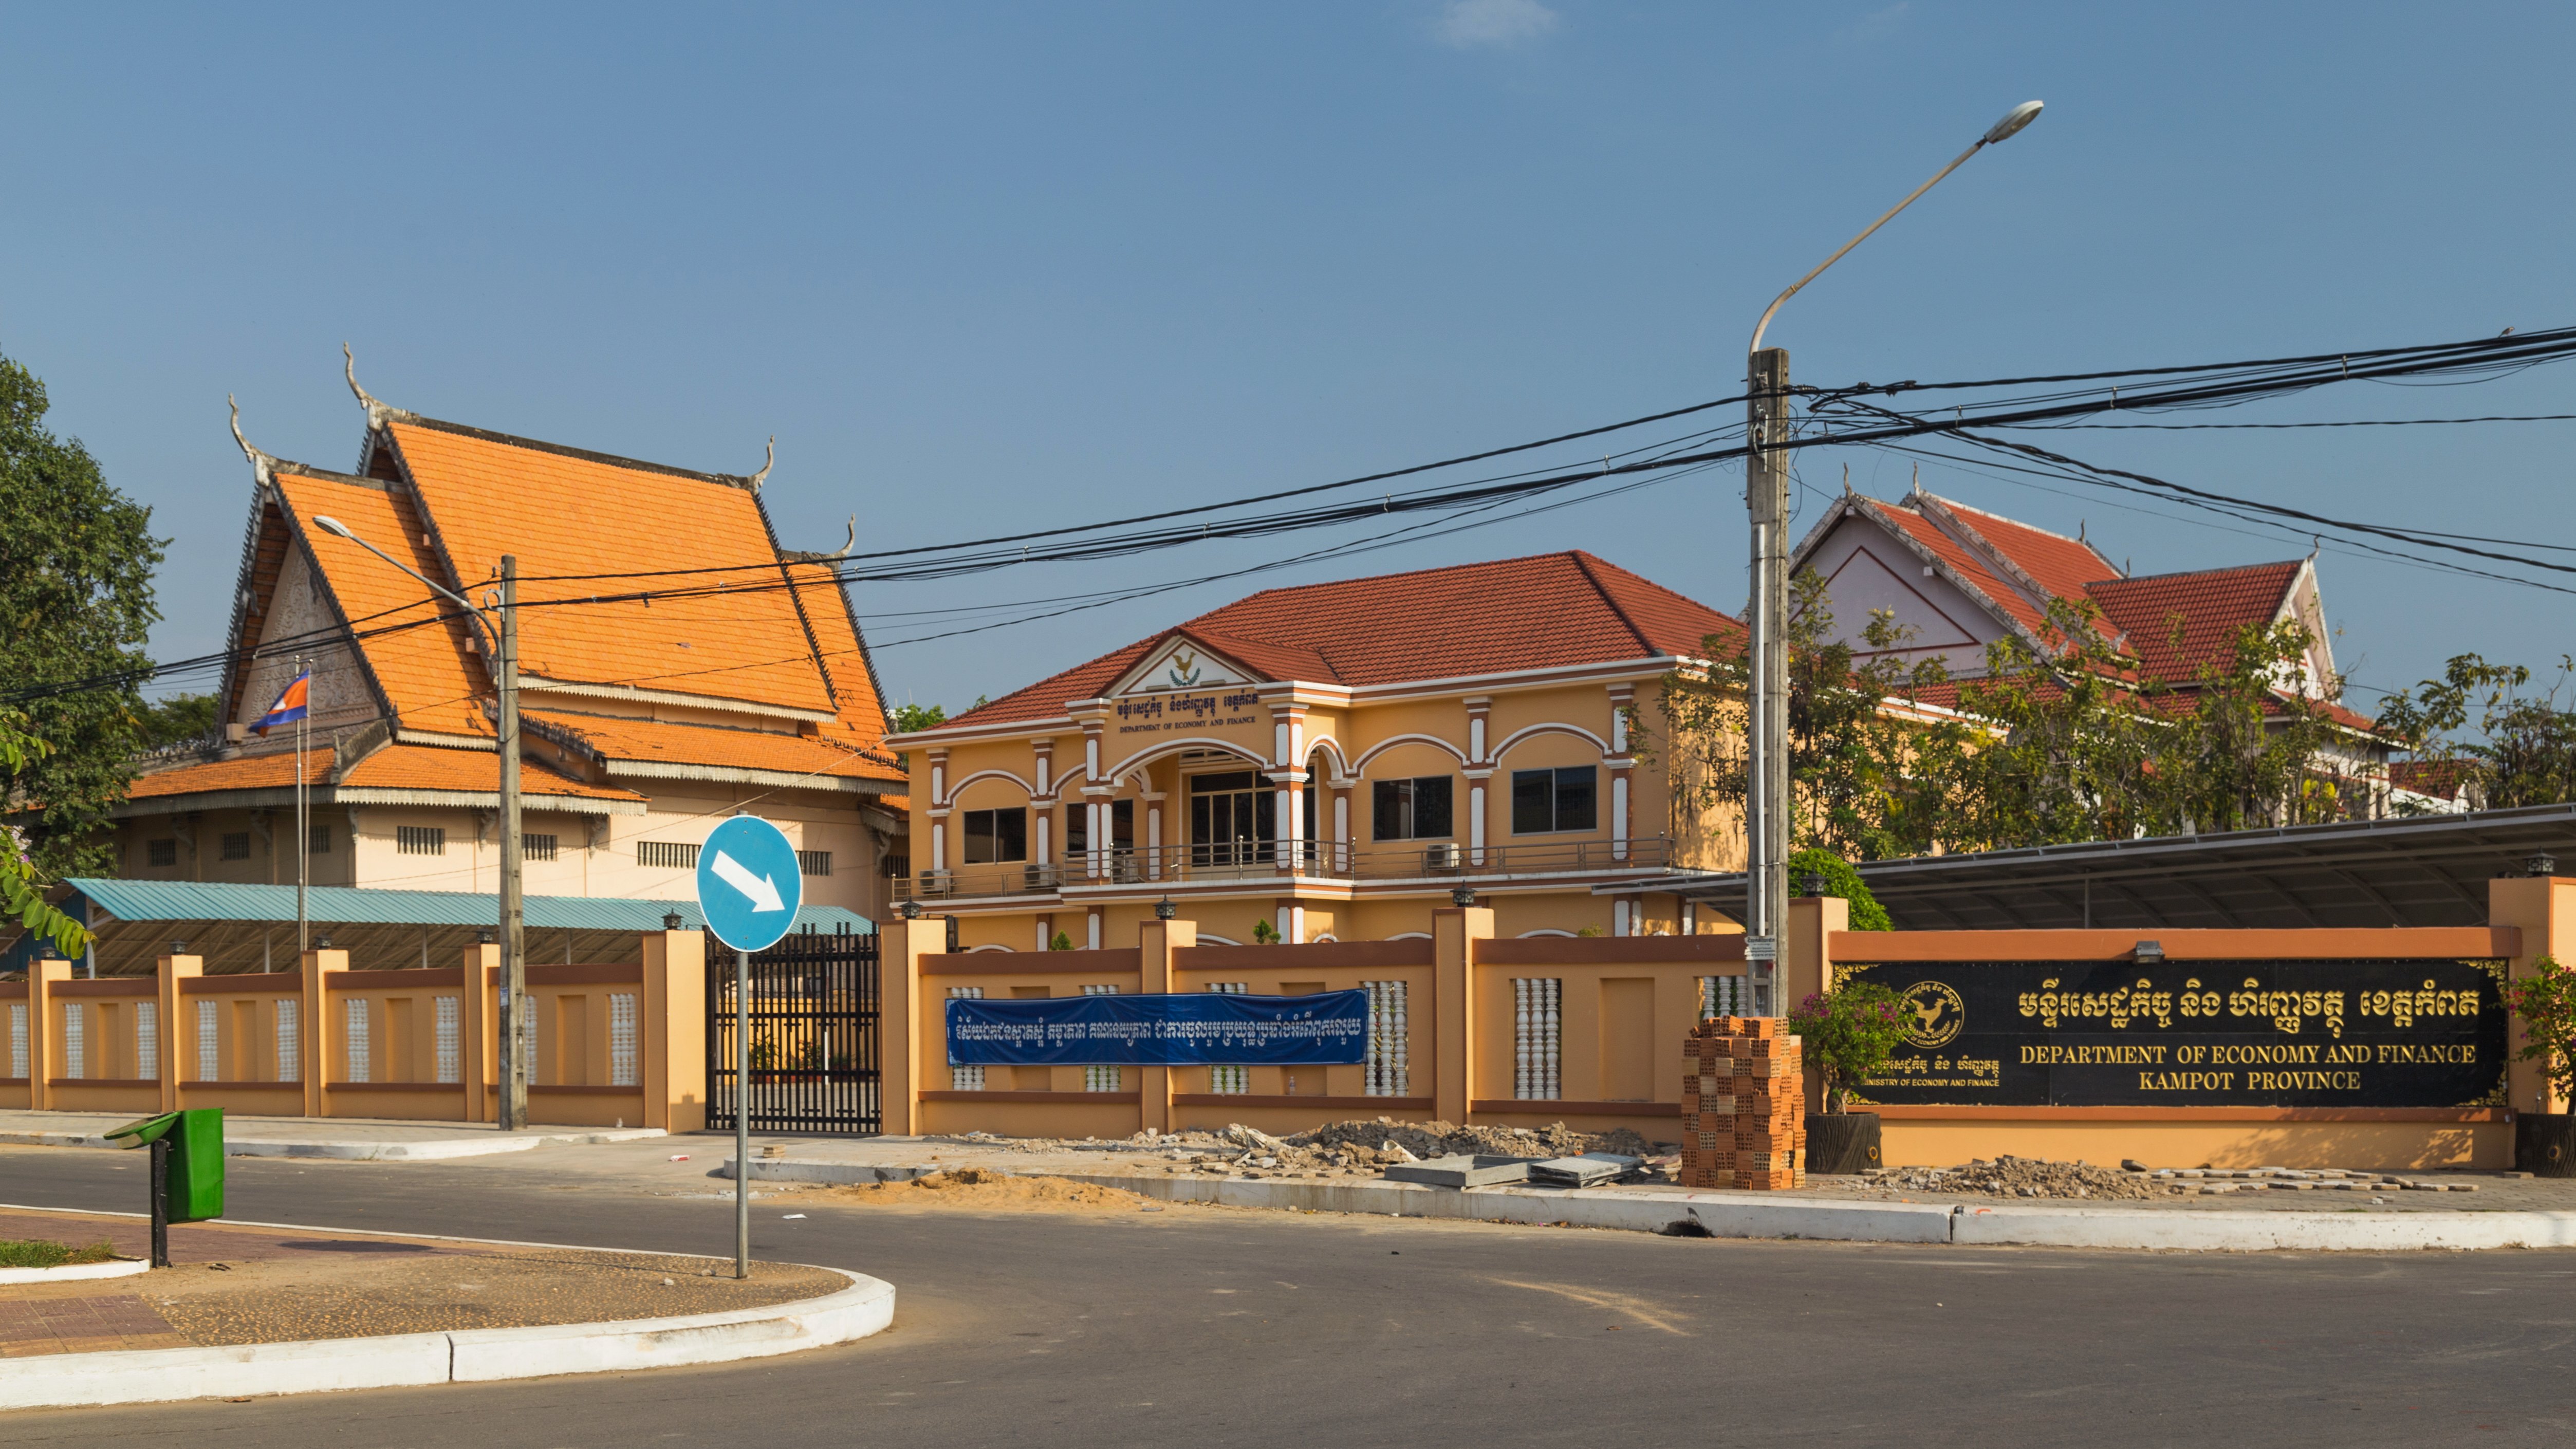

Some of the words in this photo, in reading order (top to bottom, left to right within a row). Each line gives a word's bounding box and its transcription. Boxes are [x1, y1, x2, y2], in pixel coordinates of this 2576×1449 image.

[1120, 723, 1160, 733] DEPARTMENT
[1175, 720, 1207, 729] ECONOMY
[1227, 716, 1256, 725] FINANCE
[2018, 978, 2172, 1028] មន្ទីរសេដ្ឋកិច្ច
[2180, 978, 2221, 1017] និង
[2360, 979, 2480, 1028] ខេត្តកំពត
[1935, 1055, 1951, 1070] និង
[2021, 1046, 2167, 1064] DEPARTMENT
[2177, 1046, 2207, 1064] OF
[2212, 1046, 2320, 1064] ECONOMY
[2325, 1045, 2372, 1064] AND
[2378, 1045, 2476, 1063] FINANCE
[1900, 1079, 1911, 1087] OF
[1912, 1079, 1948, 1087] ECONOMY
[1950, 1079, 1966, 1087] AND
[1968, 1079, 1999, 1087] FINANCE
[2140, 1072, 2234, 1090] KAMPOT
[2248, 1072, 2361, 1090] PROVINCE
